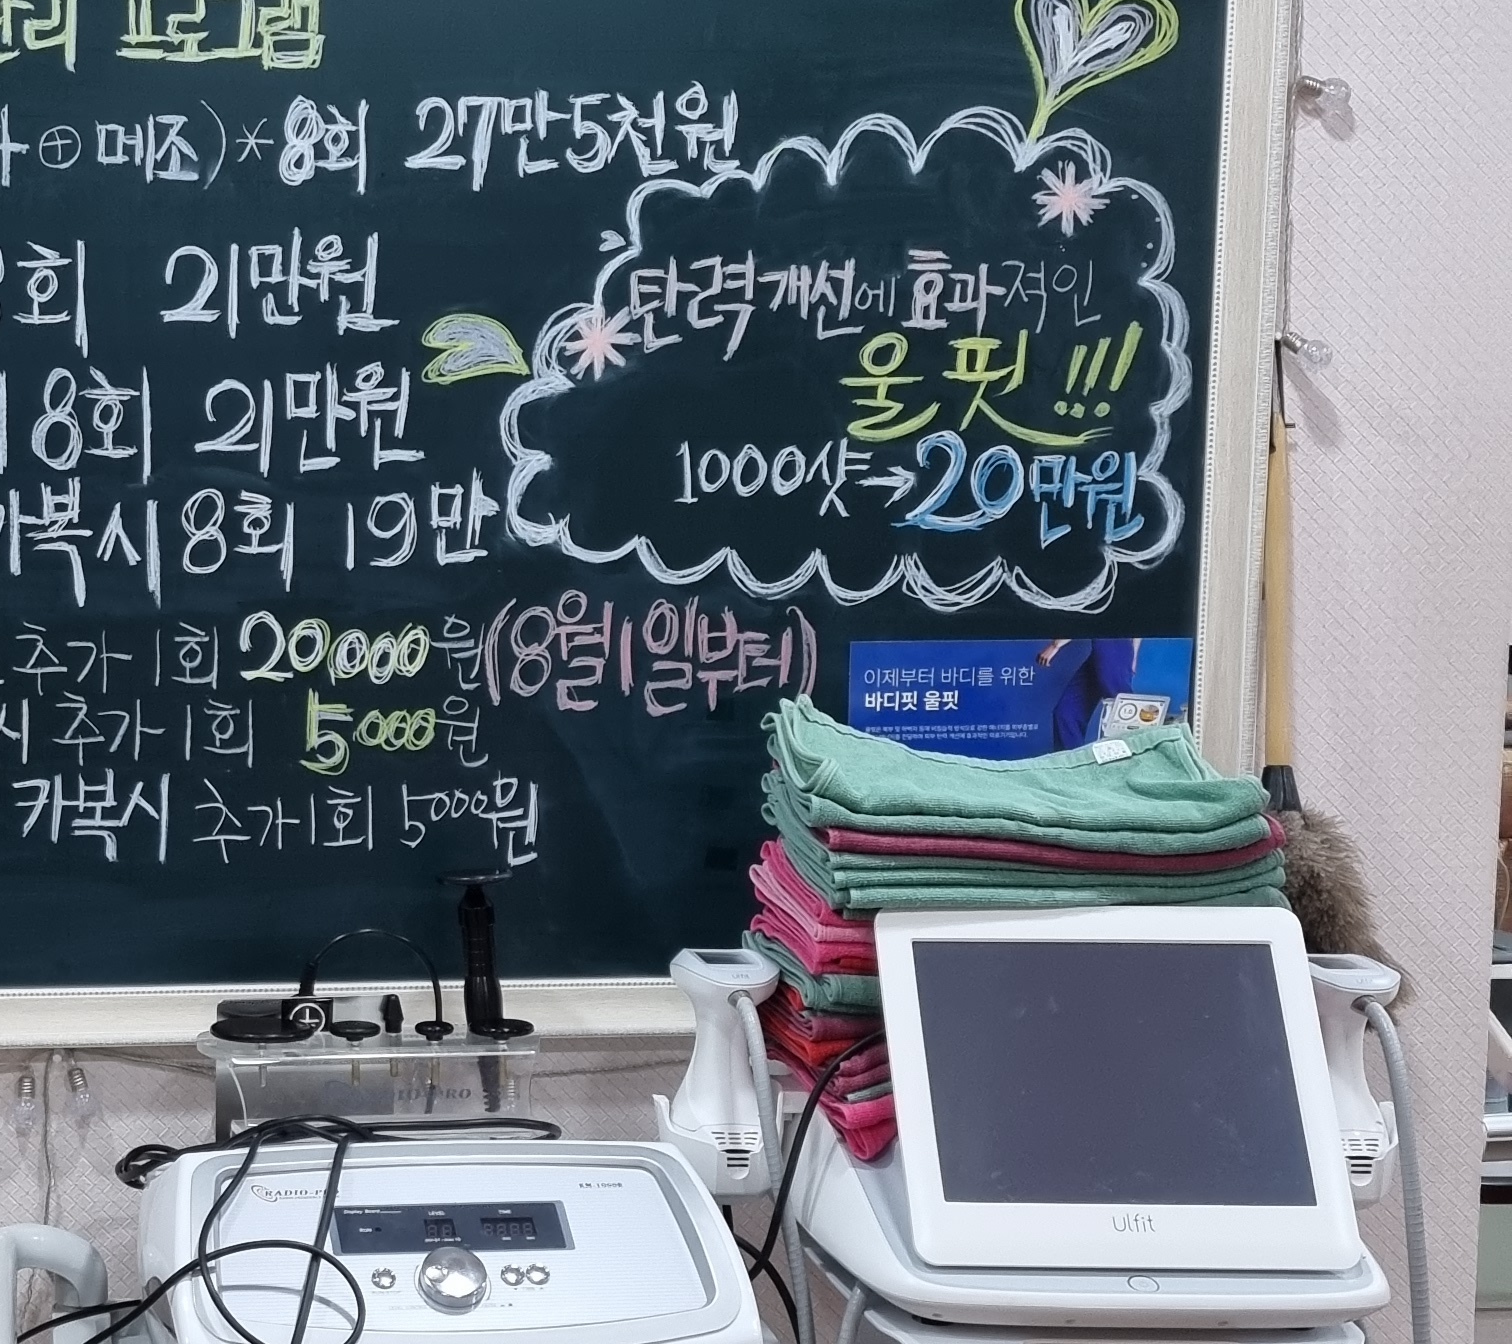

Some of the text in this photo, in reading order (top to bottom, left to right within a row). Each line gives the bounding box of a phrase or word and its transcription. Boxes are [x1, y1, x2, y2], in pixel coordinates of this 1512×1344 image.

[160, 226, 401, 339] 21만원
[194, 361, 426, 478] 21만원
[12, 620, 133, 695] 추가
[863, 665, 1036, 687] 이제부터 바디를 위한
[53, 691, 166, 767] 추가
[864, 690, 960, 712] 바디핏 울핏
[12, 768, 170, 864] 카복시
[1111, 1213, 1156, 1233] Ulfit
